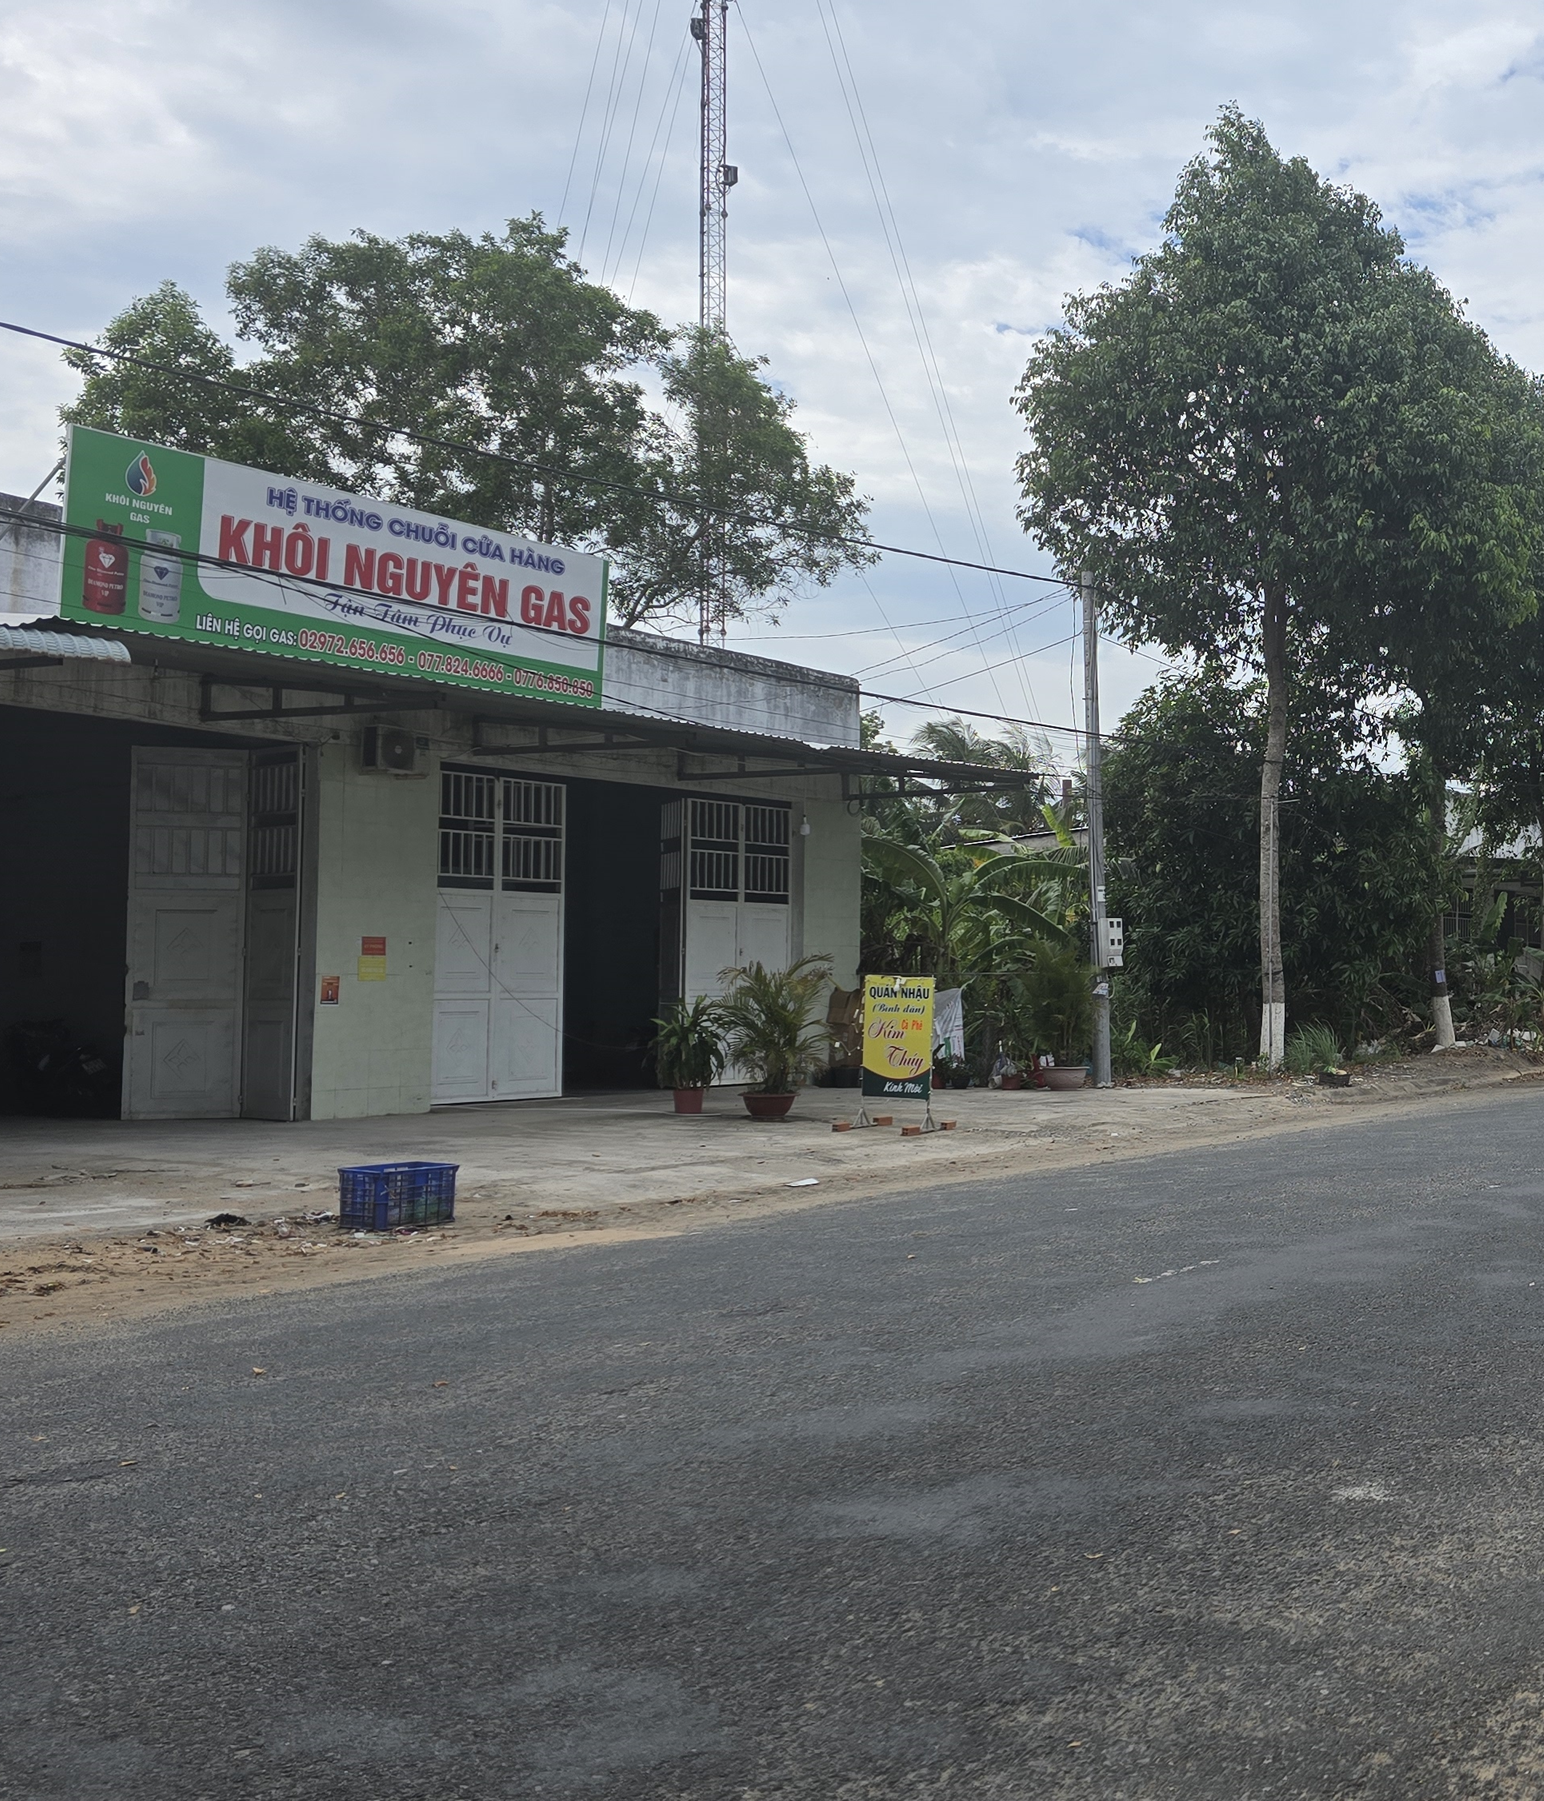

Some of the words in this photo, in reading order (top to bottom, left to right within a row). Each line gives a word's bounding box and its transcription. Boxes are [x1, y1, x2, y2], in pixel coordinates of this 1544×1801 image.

[105, 492, 129, 506] KHÔI
[132, 499, 173, 515] NGUYÊN
[130, 512, 150, 524] GAS
[266, 486, 298, 517] HỆ
[301, 498, 384, 531] THỐNG
[387, 517, 457, 550] CHUỖI
[461, 534, 506, 563] CỬA
[509, 545, 565, 575] HÀNG
[218, 514, 330, 580] KHÔI
[343, 543, 509, 619] NGUYÊN
[520, 584, 591, 635] GAS
[324, 593, 365, 617] Tận
[374, 603, 420, 627] Tâm
[427, 614, 477, 639] Phục
[482, 625, 514, 648] Vụ
[196, 612, 222, 633] LIÊN
[224, 618, 240, 640] HỆ
[243, 624, 266, 643] GỌI
[269, 628, 297, 647] GAS:
[299, 629, 405, 665] 02972.656.656
[417, 651, 504, 682] 077.824.6666
[869, 984, 897, 999] QUÁN
[901, 985, 930, 1001] NHẬU
[868, 1017, 905, 1039] Kim
[885, 1045, 924, 1076] Thúy
